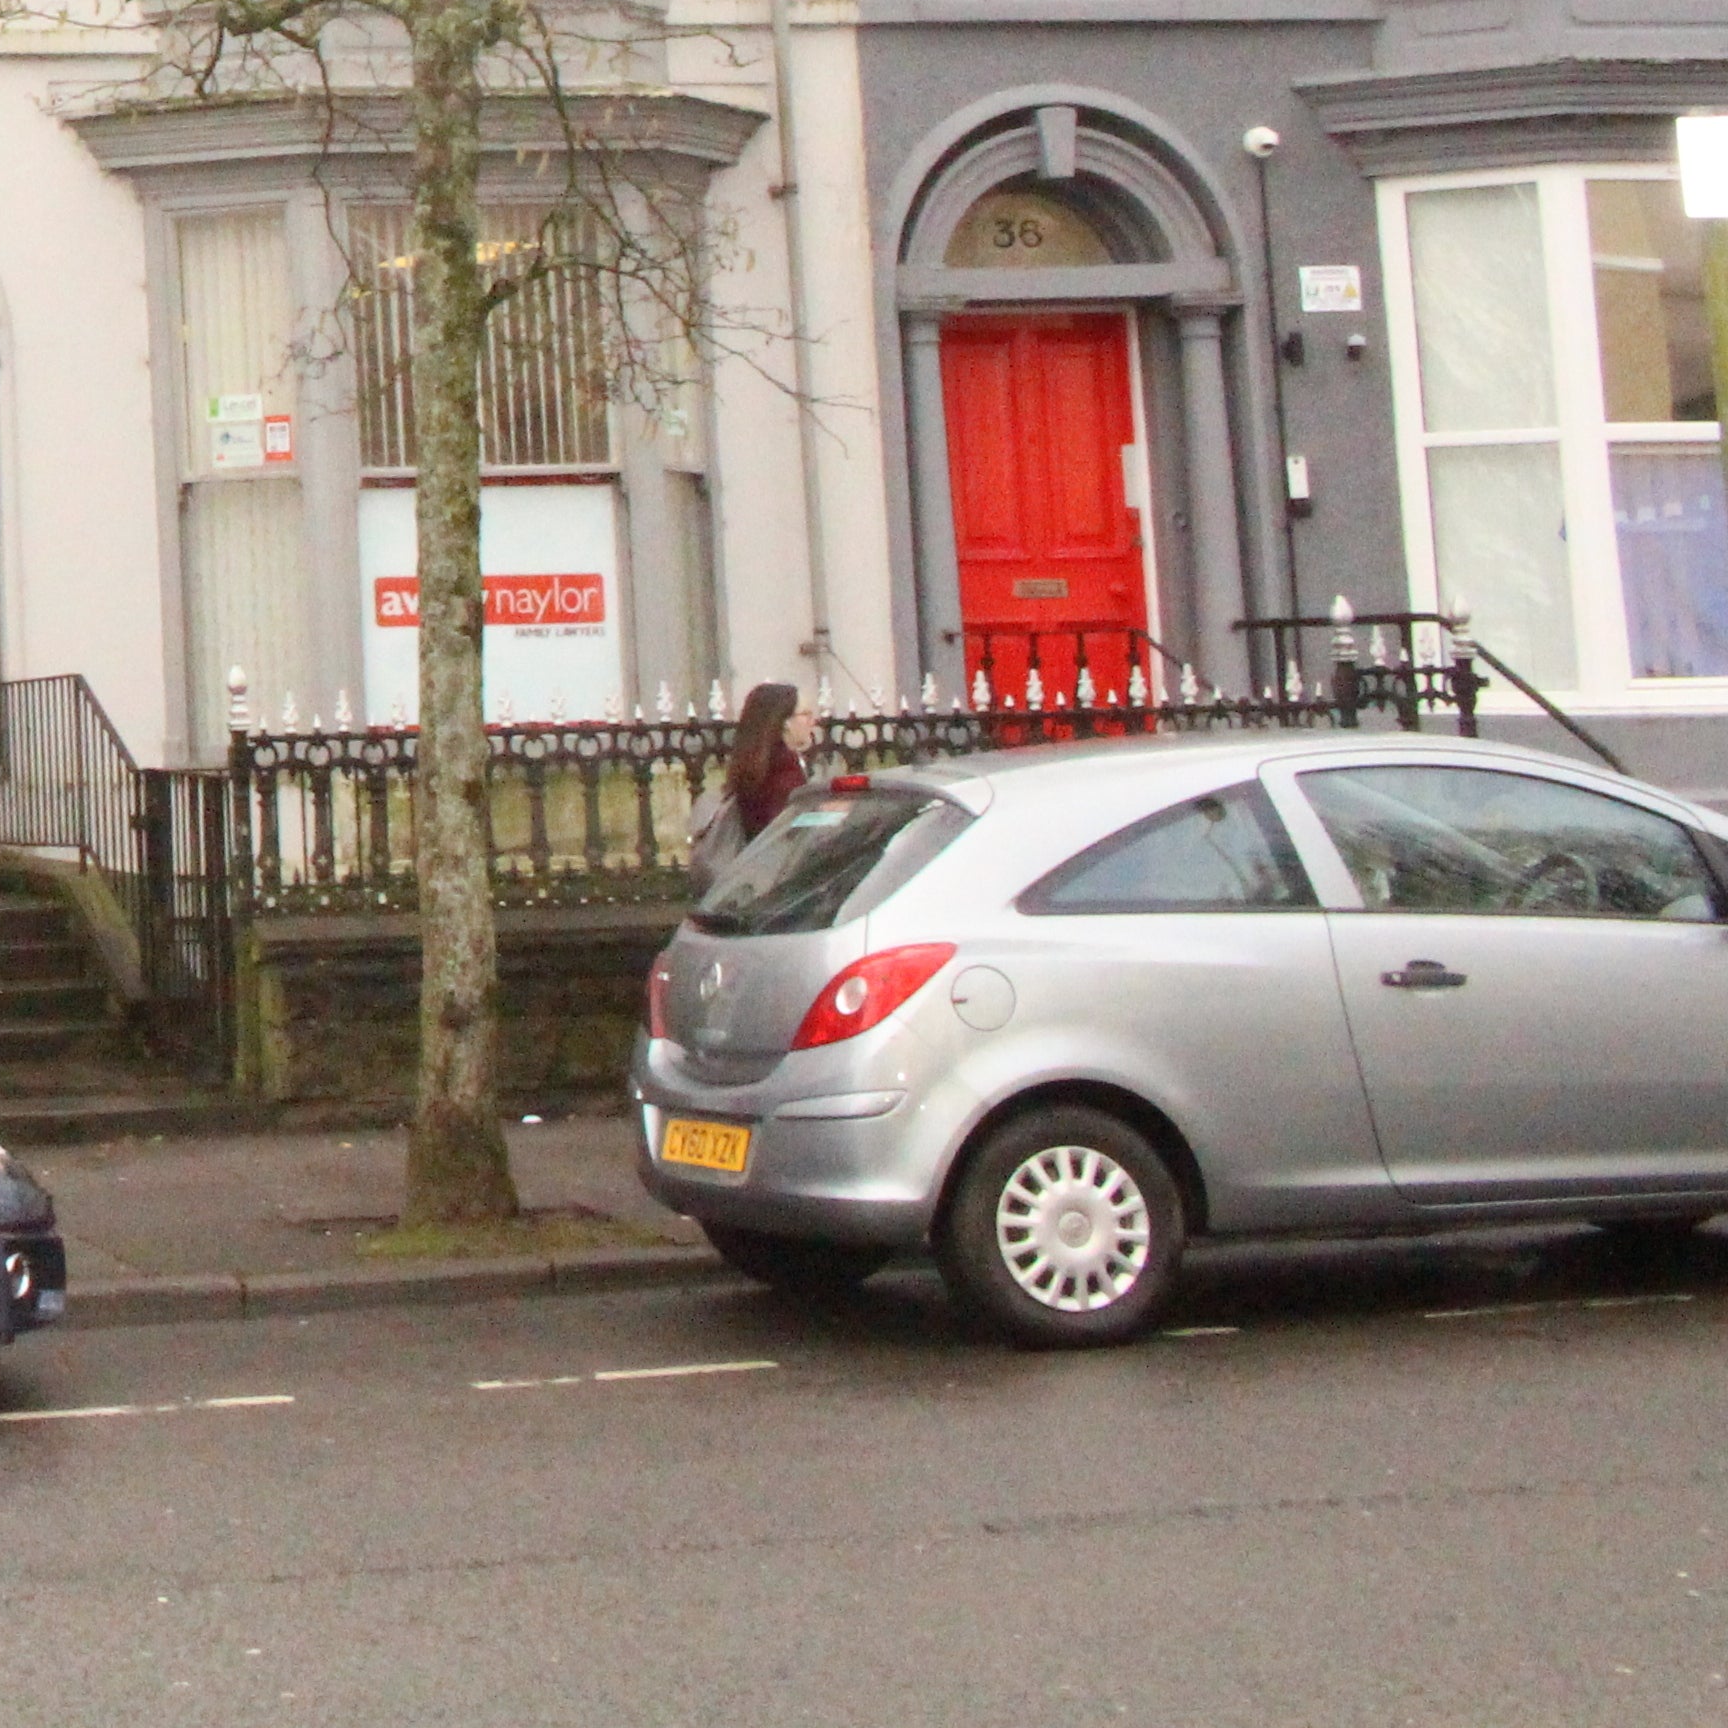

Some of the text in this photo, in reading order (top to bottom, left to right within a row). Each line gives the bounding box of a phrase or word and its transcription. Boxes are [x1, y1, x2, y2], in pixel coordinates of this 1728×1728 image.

[495, 576, 599, 623] naylor
[514, 625, 606, 638] FAMILY LAWYERS
